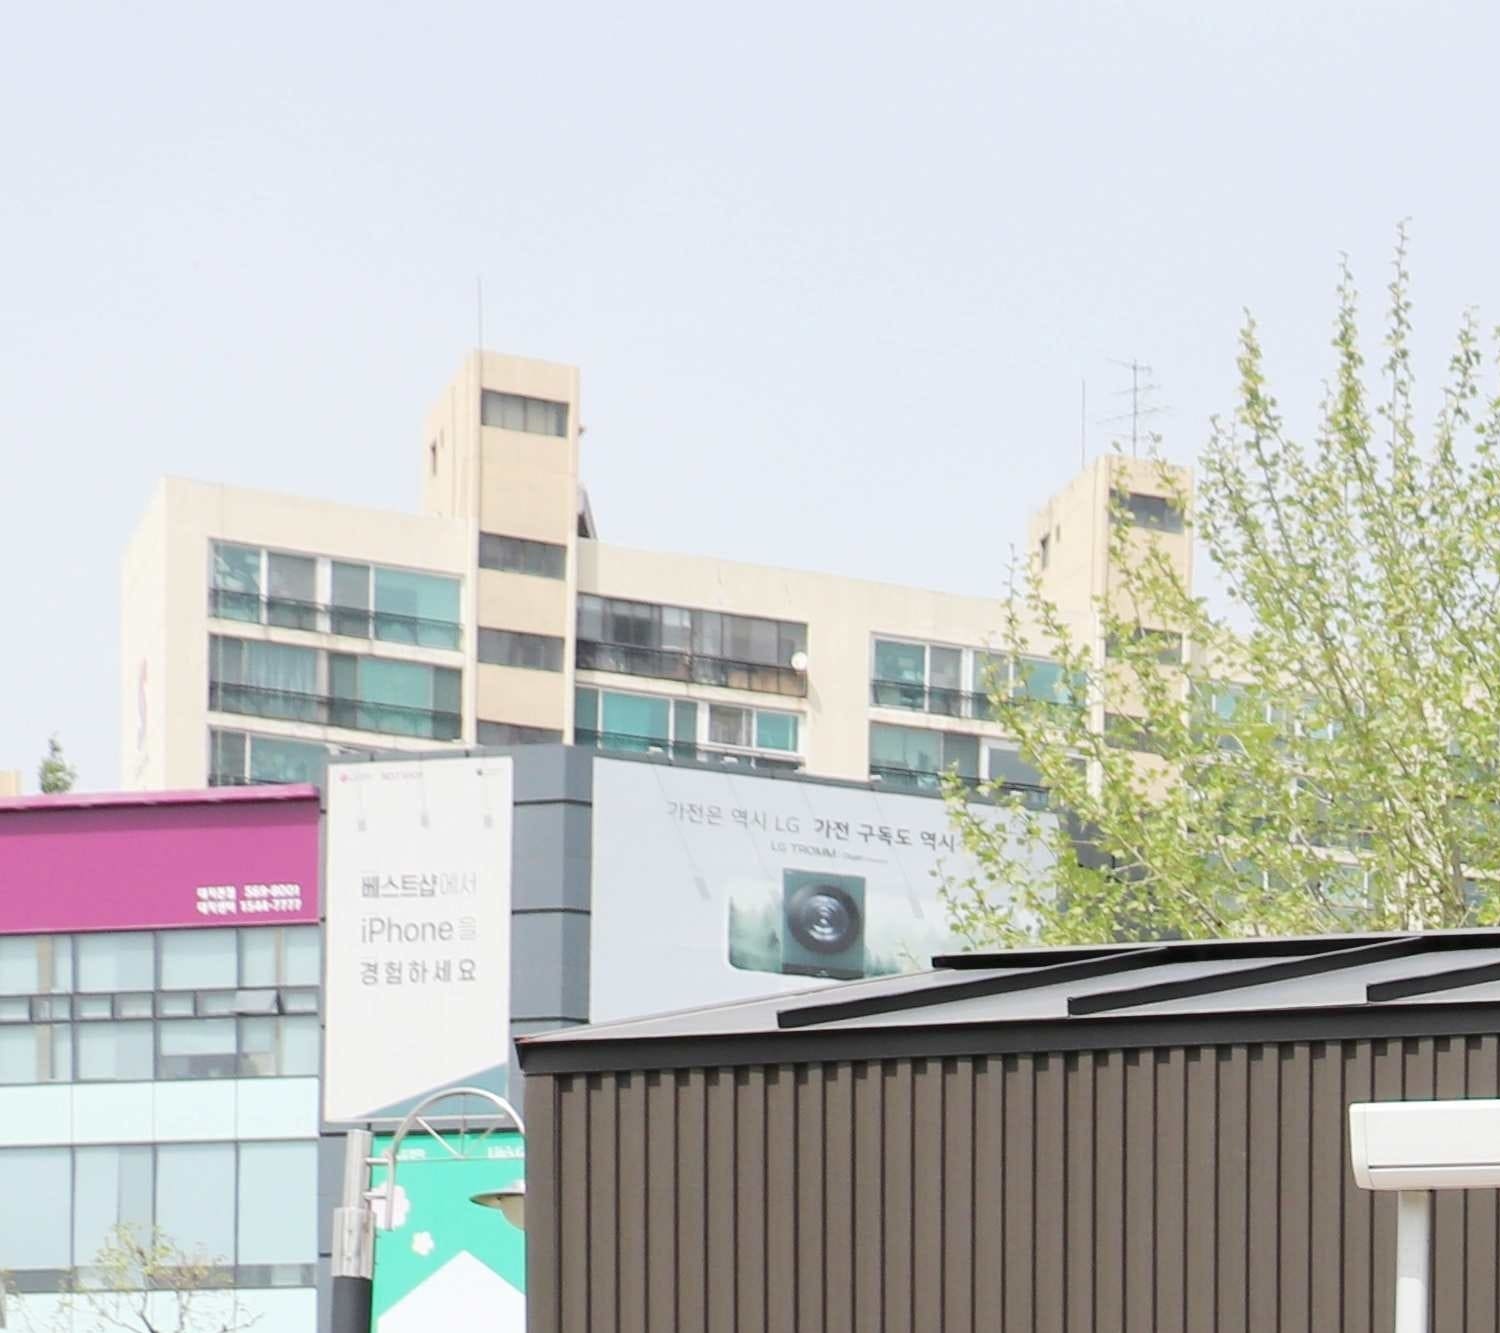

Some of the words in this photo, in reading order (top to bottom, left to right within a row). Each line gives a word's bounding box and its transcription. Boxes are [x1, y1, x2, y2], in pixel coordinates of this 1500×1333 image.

[668, 800, 722, 825] 가전은
[731, 806, 767, 832] 역시
[775, 815, 801, 833] LG
[814, 818, 849, 841] 가전
[857, 824, 912, 846] 구독도
[920, 831, 956, 853] 역시
[361, 872, 477, 898] 베스트샵에서
[360, 958, 477, 986] 경험하세요
